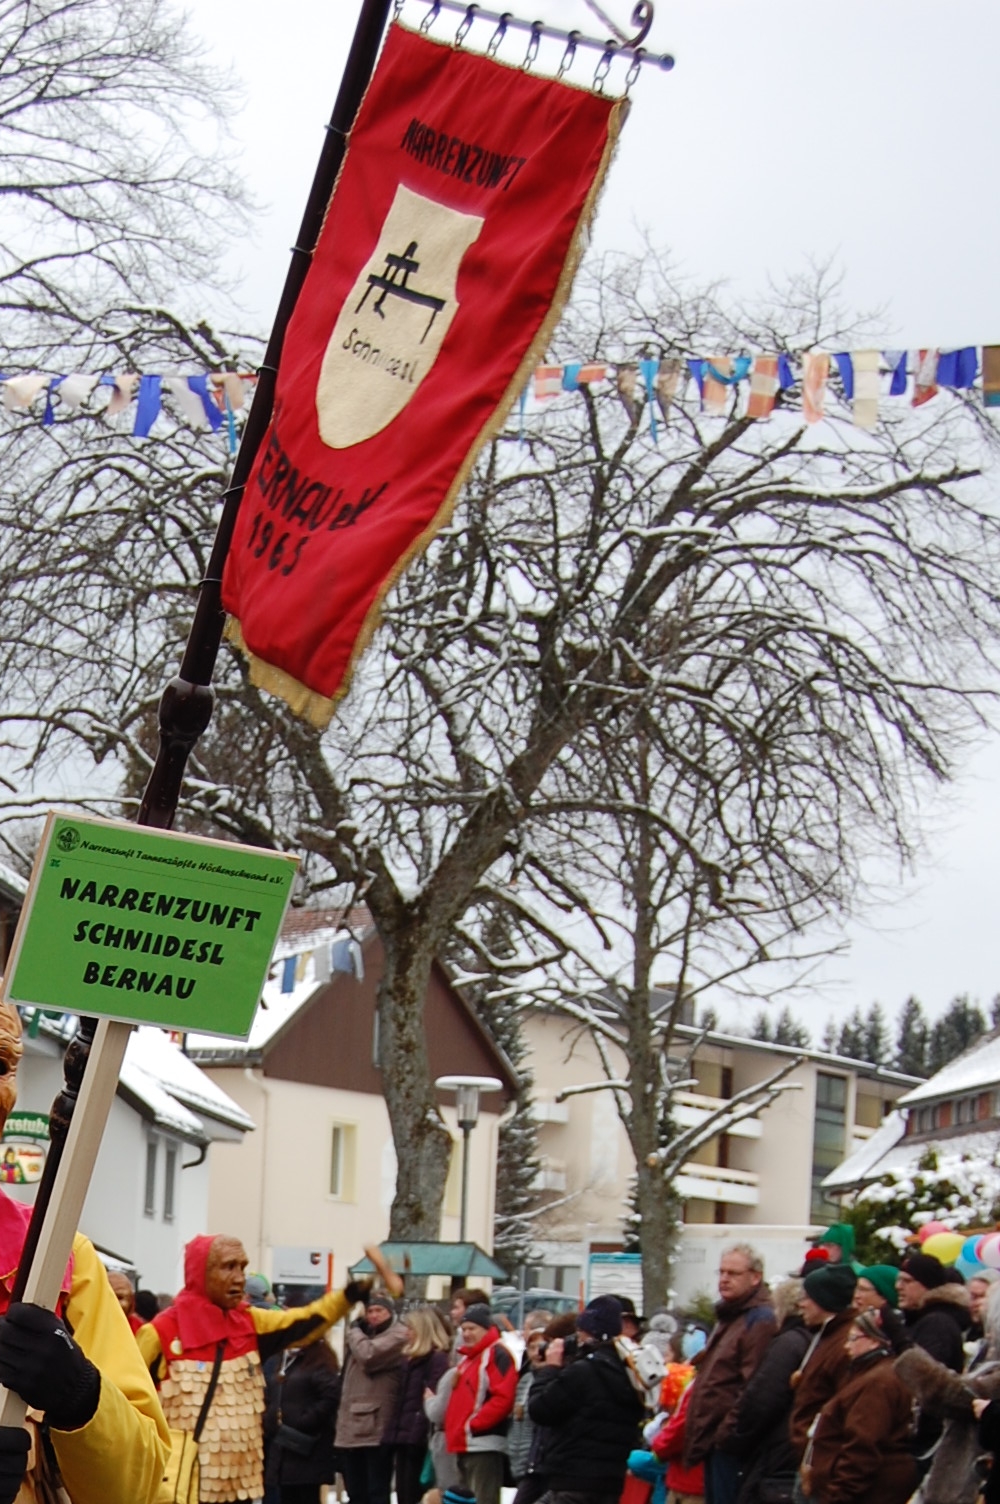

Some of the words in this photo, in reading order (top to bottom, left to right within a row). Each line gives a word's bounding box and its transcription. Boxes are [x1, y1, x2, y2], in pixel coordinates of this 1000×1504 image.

[400, 117, 528, 193] NARRENZUNFT
[257, 415, 344, 531] ERNAU
[248, 512, 310, 576] 1965
[80, 840, 135, 859] Narrenzunft
[59, 877, 262, 932] NARRENZUNFT
[73, 920, 225, 966] SCHNIIDESL
[82, 961, 196, 999] BERNAU
